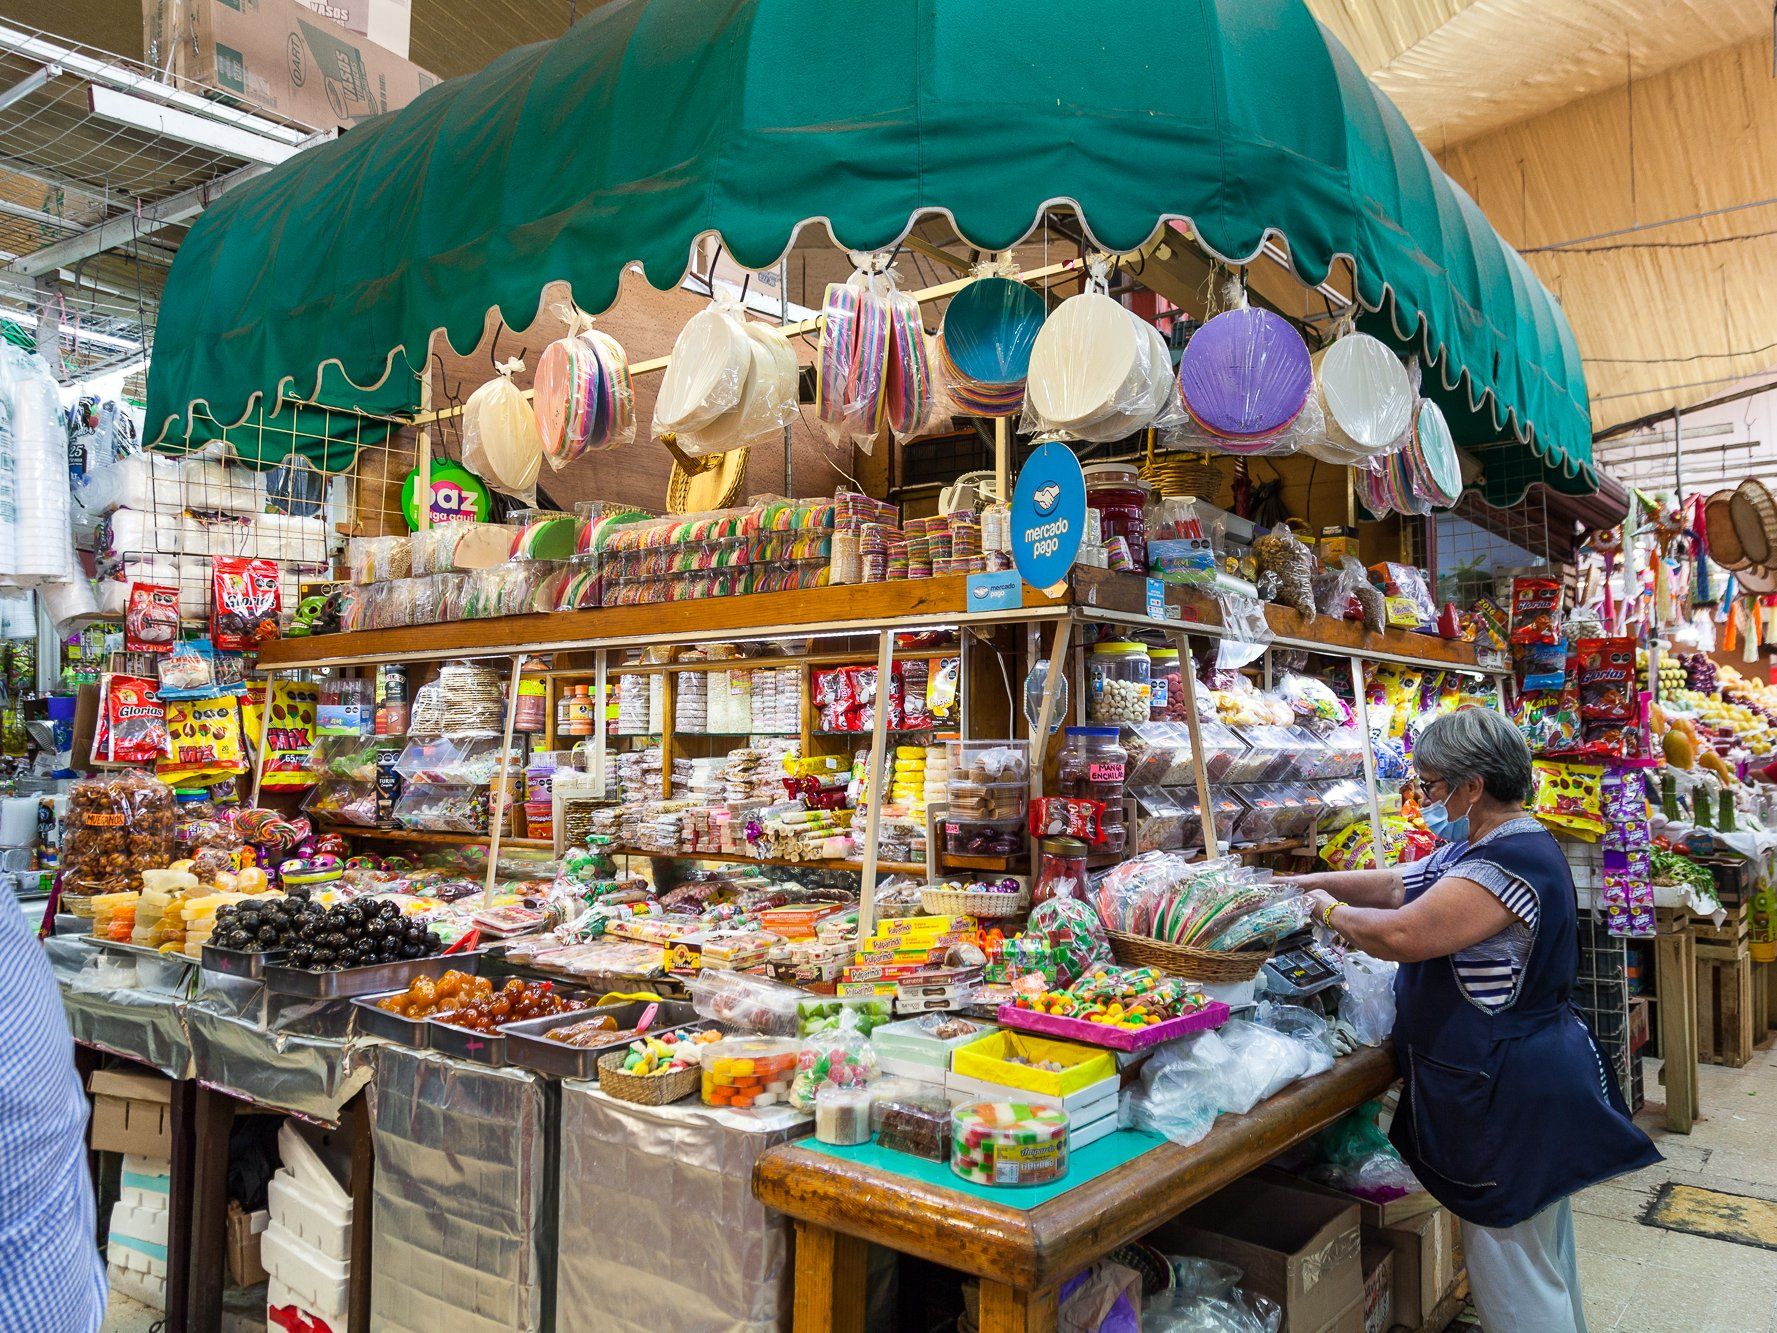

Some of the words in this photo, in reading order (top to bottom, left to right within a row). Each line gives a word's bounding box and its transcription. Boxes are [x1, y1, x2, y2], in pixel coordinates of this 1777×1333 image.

[291, 38, 302, 82] DART
[69, 444, 83, 457] 25
[1025, 517, 1069, 542] mercado
[1033, 538, 1059, 559] pago
[990, 583, 1016, 592] mercado
[990, 590, 1005, 598] pago
[1516, 599, 1555, 611] Glorias
[1580, 668, 1626, 684] Glorias
[119, 704, 164, 719] Glorias
[285, 753, 297, 763] 65
[873, 936, 902, 949] Pulparindo
[864, 952, 894, 964] Pulparindo
[852, 968, 882, 981] Pulparindo
